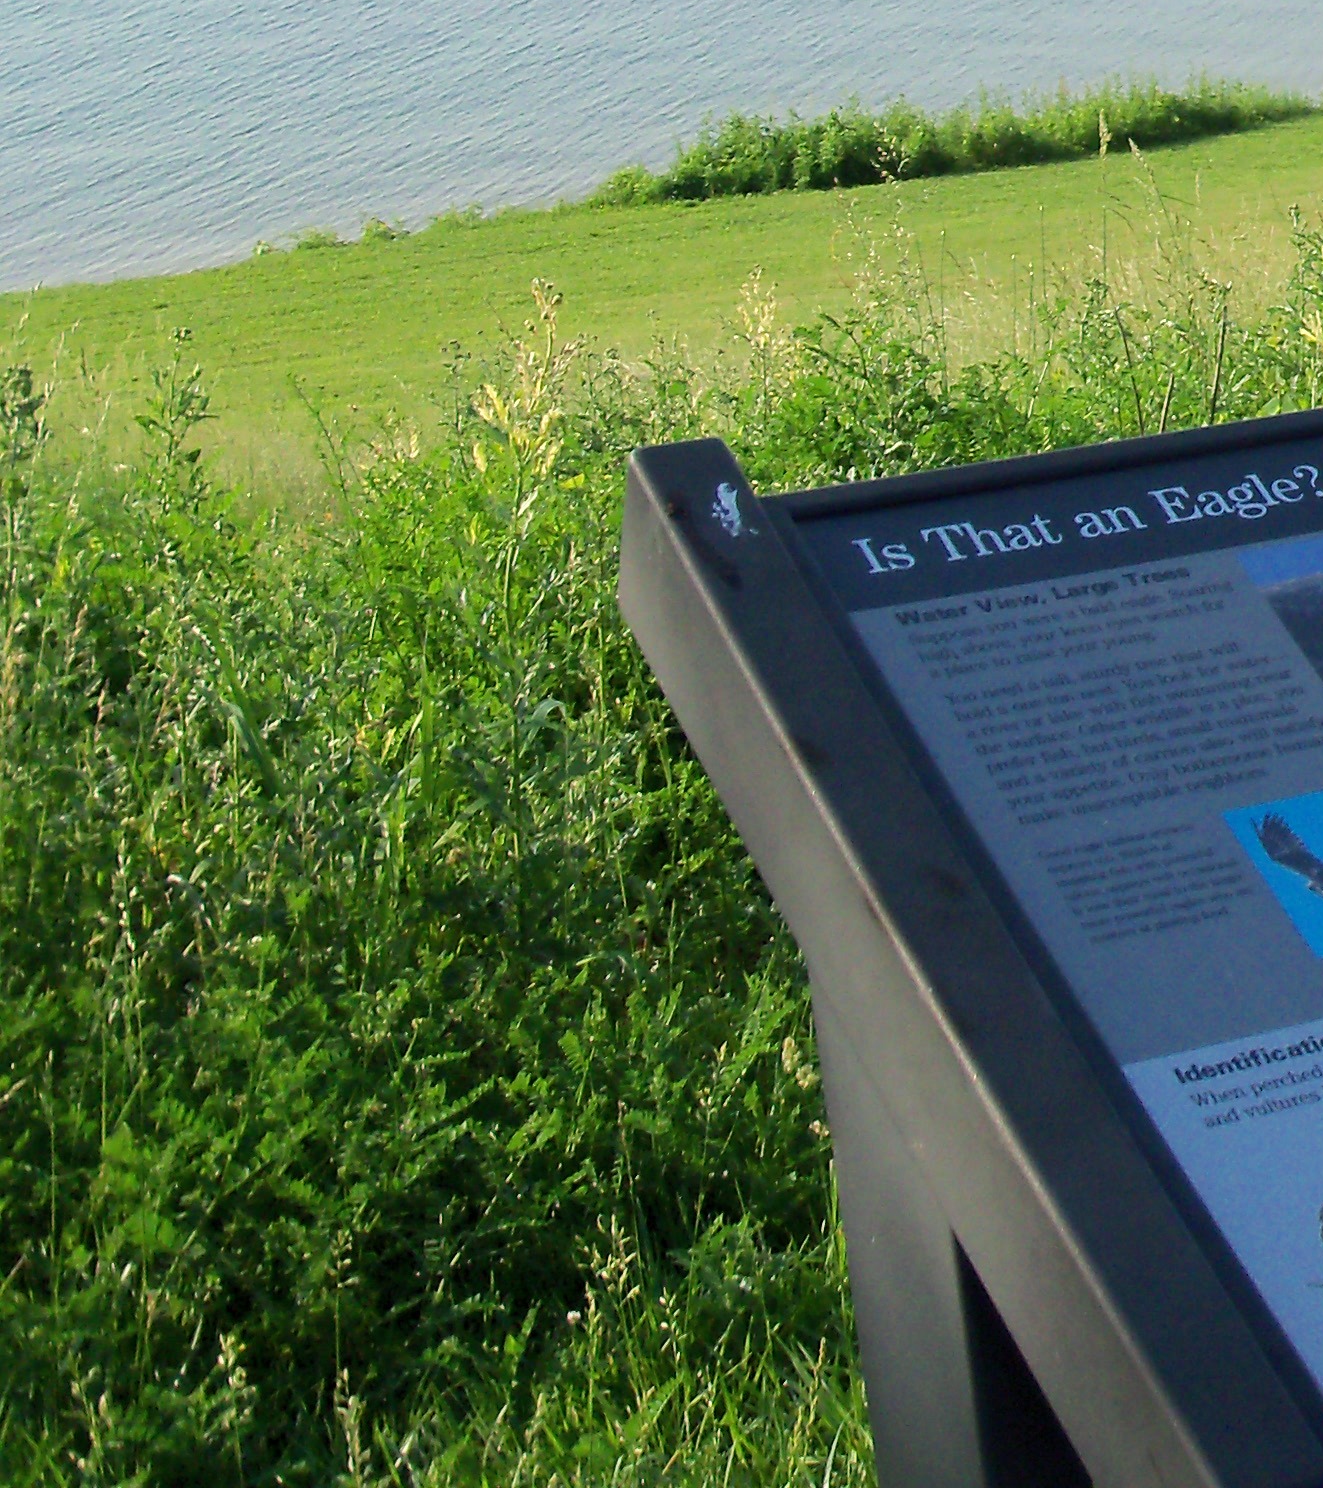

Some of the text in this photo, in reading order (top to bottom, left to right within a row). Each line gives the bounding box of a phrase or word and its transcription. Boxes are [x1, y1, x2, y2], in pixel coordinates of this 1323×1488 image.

[851, 535, 915, 576] Is
[921, 512, 1063, 564] That
[1073, 504, 1149, 540] an
[894, 567, 1191, 626] Water View, Large Trees
[1189, 1088, 1247, 1107] When
[1206, 1108, 1241, 1128] and
[1243, 1091, 1322, 1118] vultures
